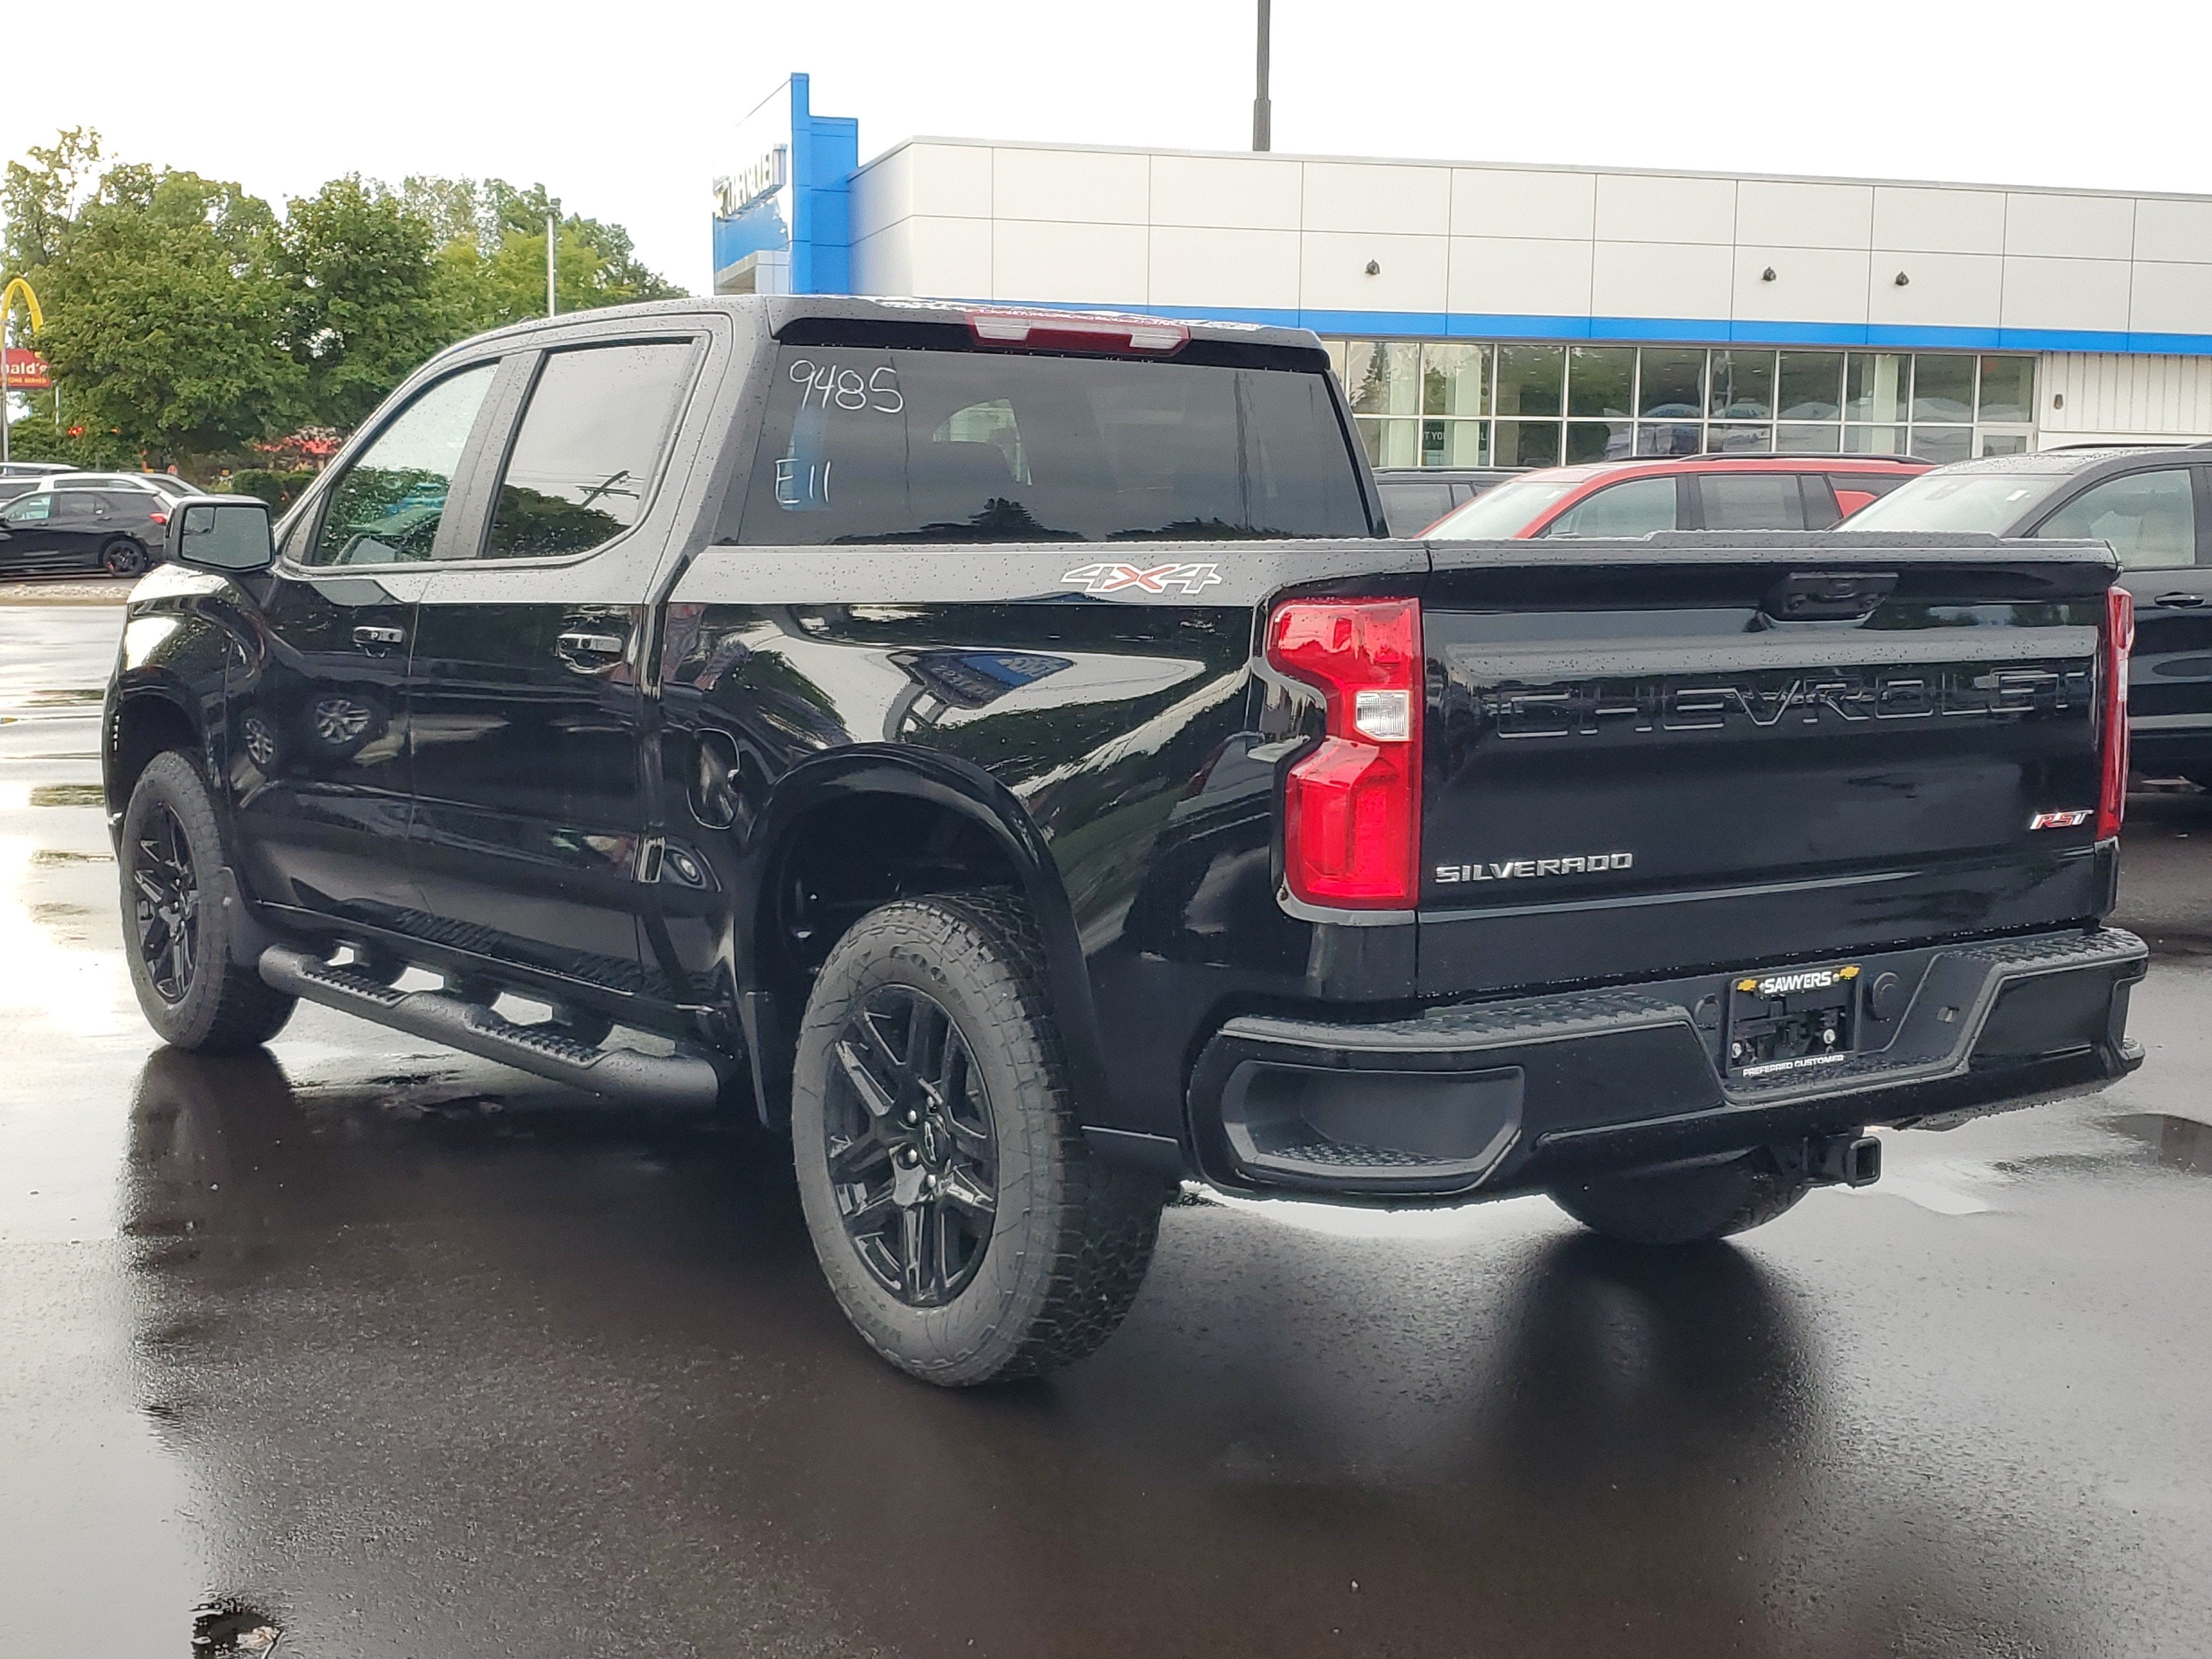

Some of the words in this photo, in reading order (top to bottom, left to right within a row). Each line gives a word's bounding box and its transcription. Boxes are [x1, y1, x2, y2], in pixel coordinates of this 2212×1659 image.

[789, 359, 904, 413] 9485
[2030, 809, 2094, 830] RST
[1435, 853, 1633, 883] SILVERADO
[1764, 971, 1832, 994] SAWYERS
[1743, 1062, 1793, 1077] PREFERRED
[1794, 1054, 1845, 1068] CUSTOMER
